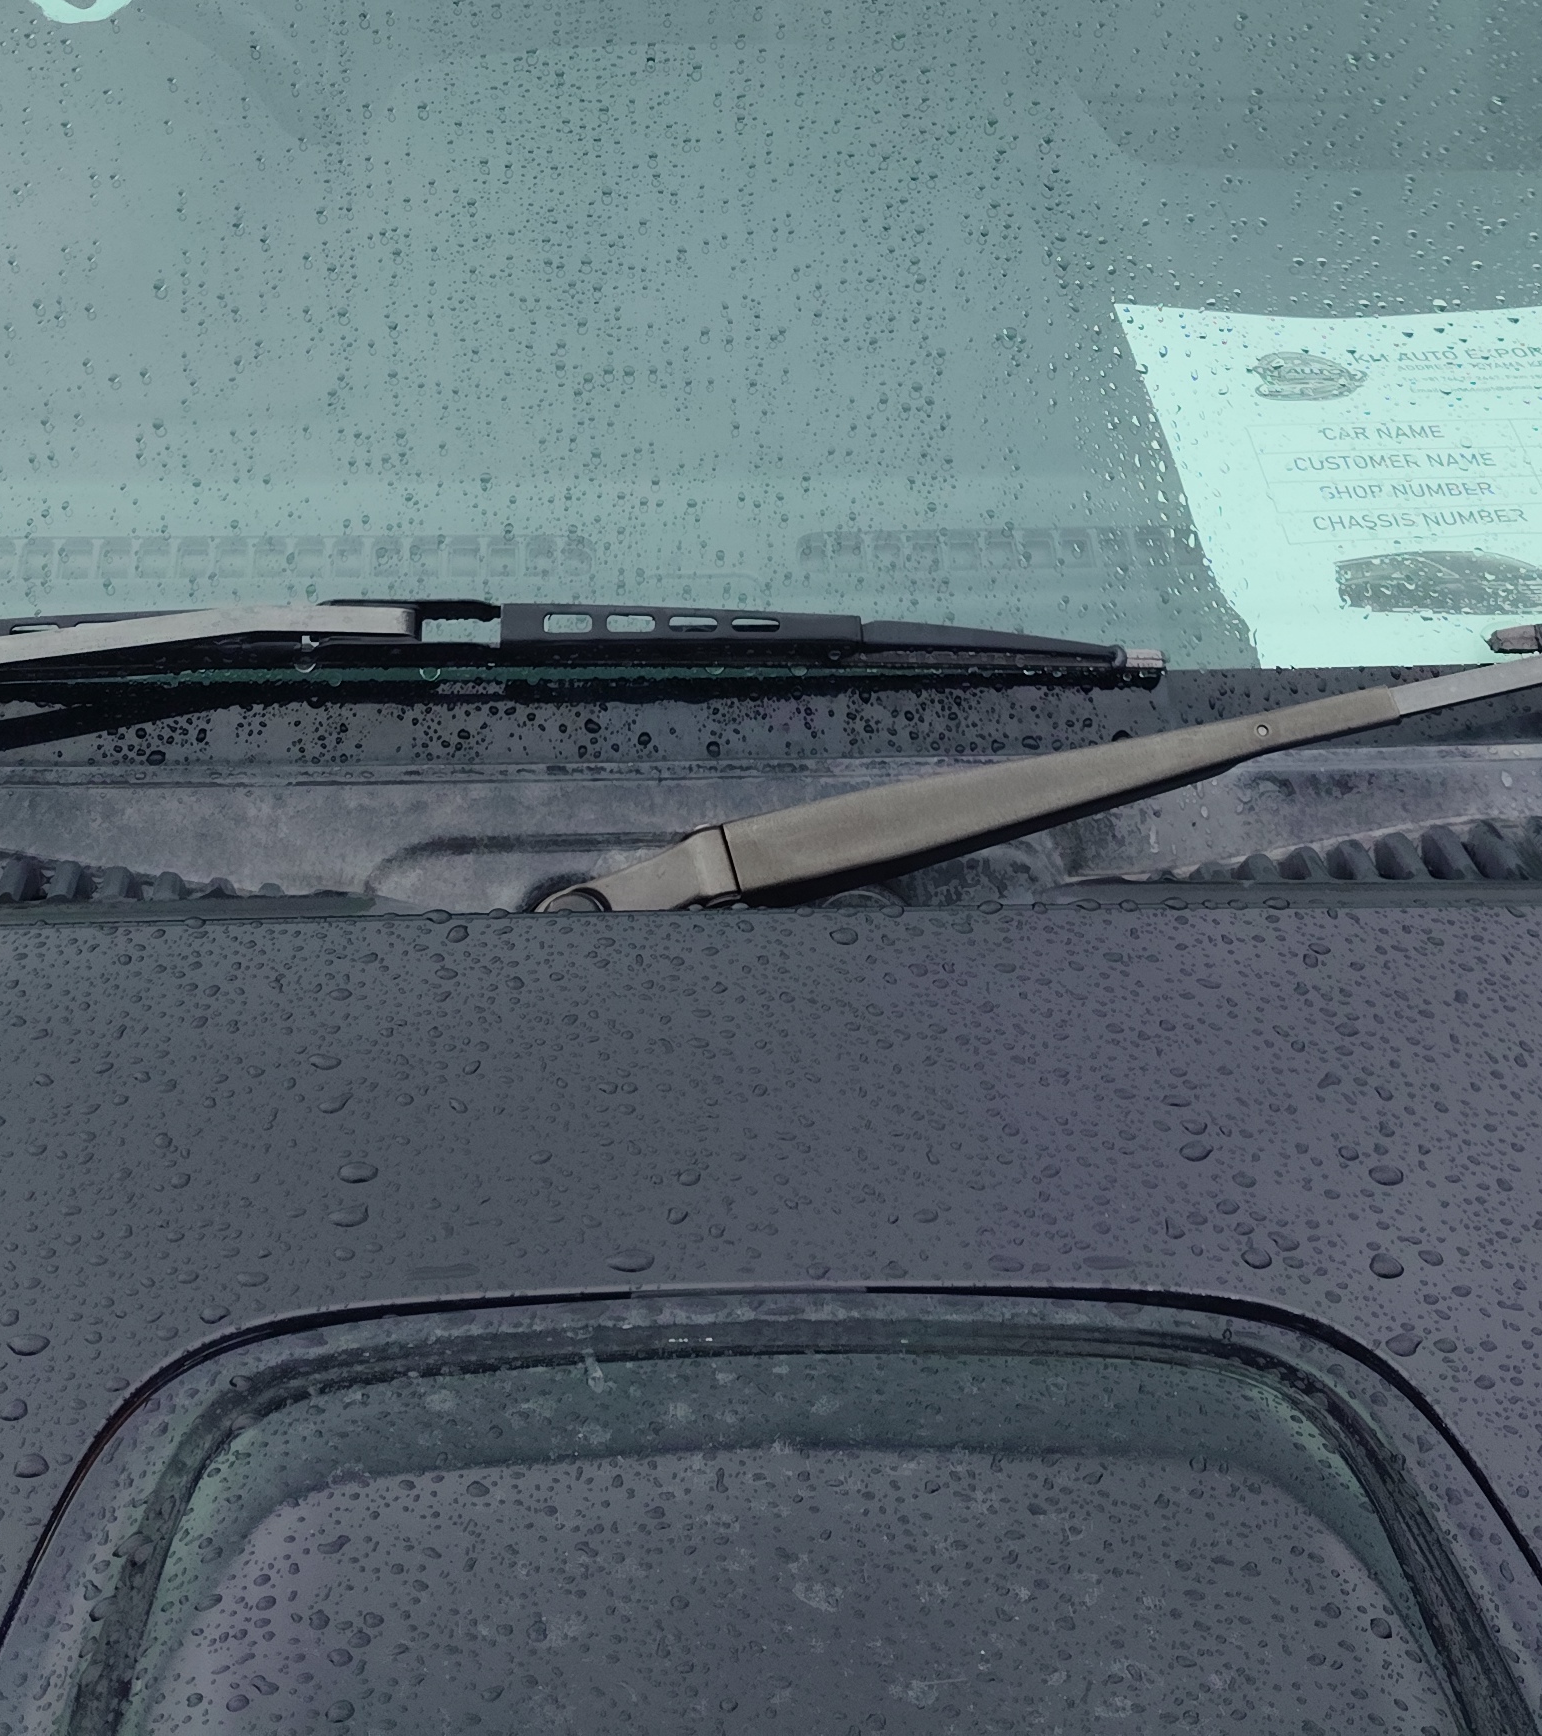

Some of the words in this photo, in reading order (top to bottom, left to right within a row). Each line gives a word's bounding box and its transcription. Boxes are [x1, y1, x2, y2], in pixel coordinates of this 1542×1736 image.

[1396, 349, 1459, 363] AUTO
[1320, 426, 1370, 441] CAR
[1375, 424, 1445, 440] NAME
[1293, 454, 1421, 471] CUSTOMER
[1425, 451, 1497, 468] NAME
[1319, 484, 1383, 500] SHOP
[1390, 481, 1495, 499] NUMBER
[1312, 512, 1416, 532] CHASSIS
[1420, 507, 1529, 527] NUMBER
